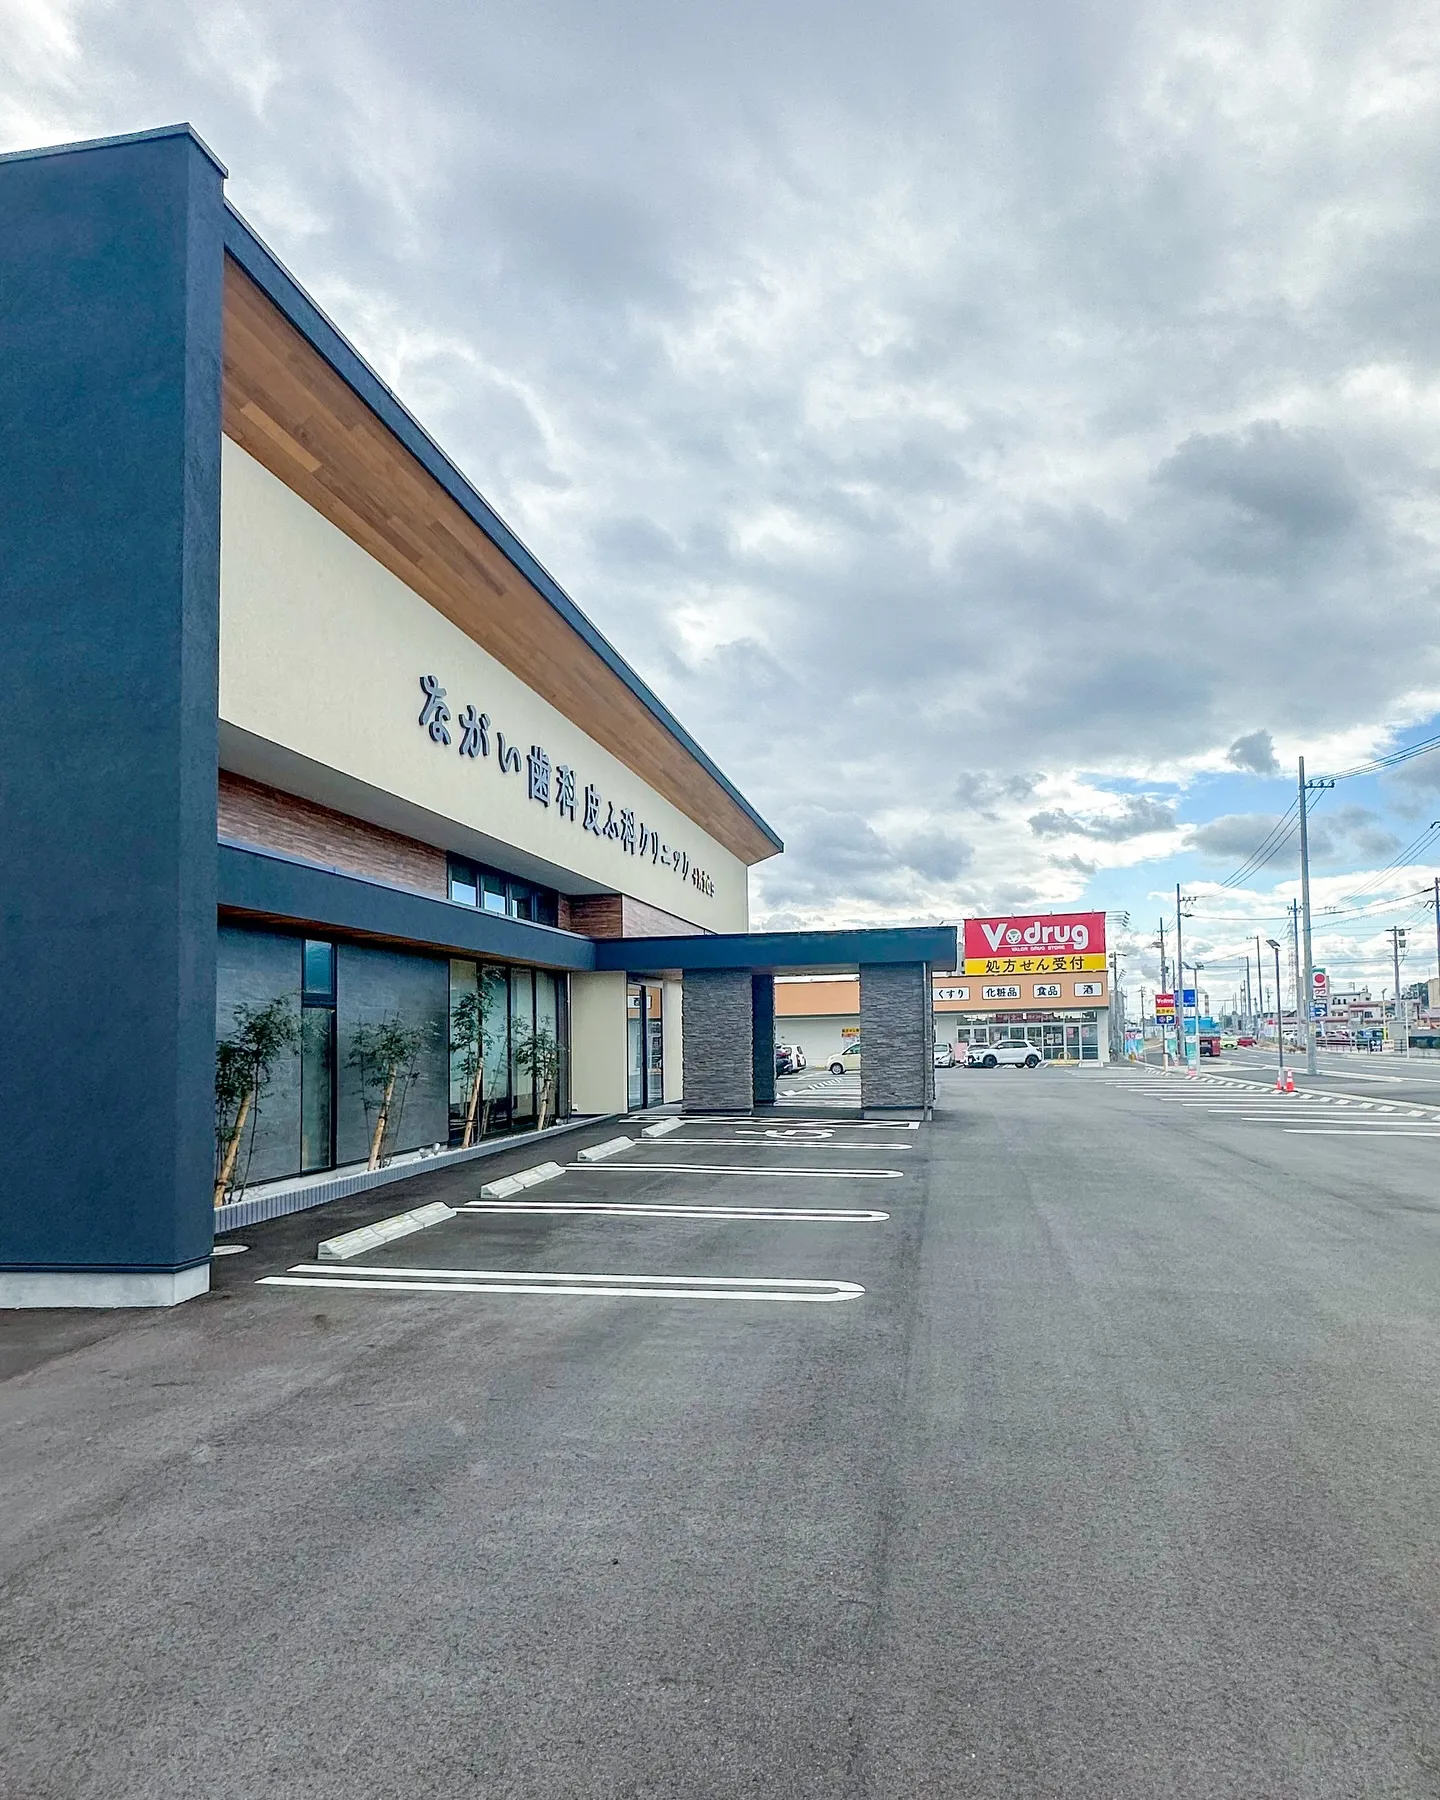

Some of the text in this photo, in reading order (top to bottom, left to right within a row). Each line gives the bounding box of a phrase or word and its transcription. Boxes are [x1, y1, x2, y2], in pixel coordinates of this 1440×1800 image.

[986, 956, 1085, 973] 処方せん受付
[938, 989, 964, 999] くすり
[986, 987, 1018, 997] 化粧品
[1036, 985, 1058, 996] 食品
[1083, 984, 1094, 995] 酒
